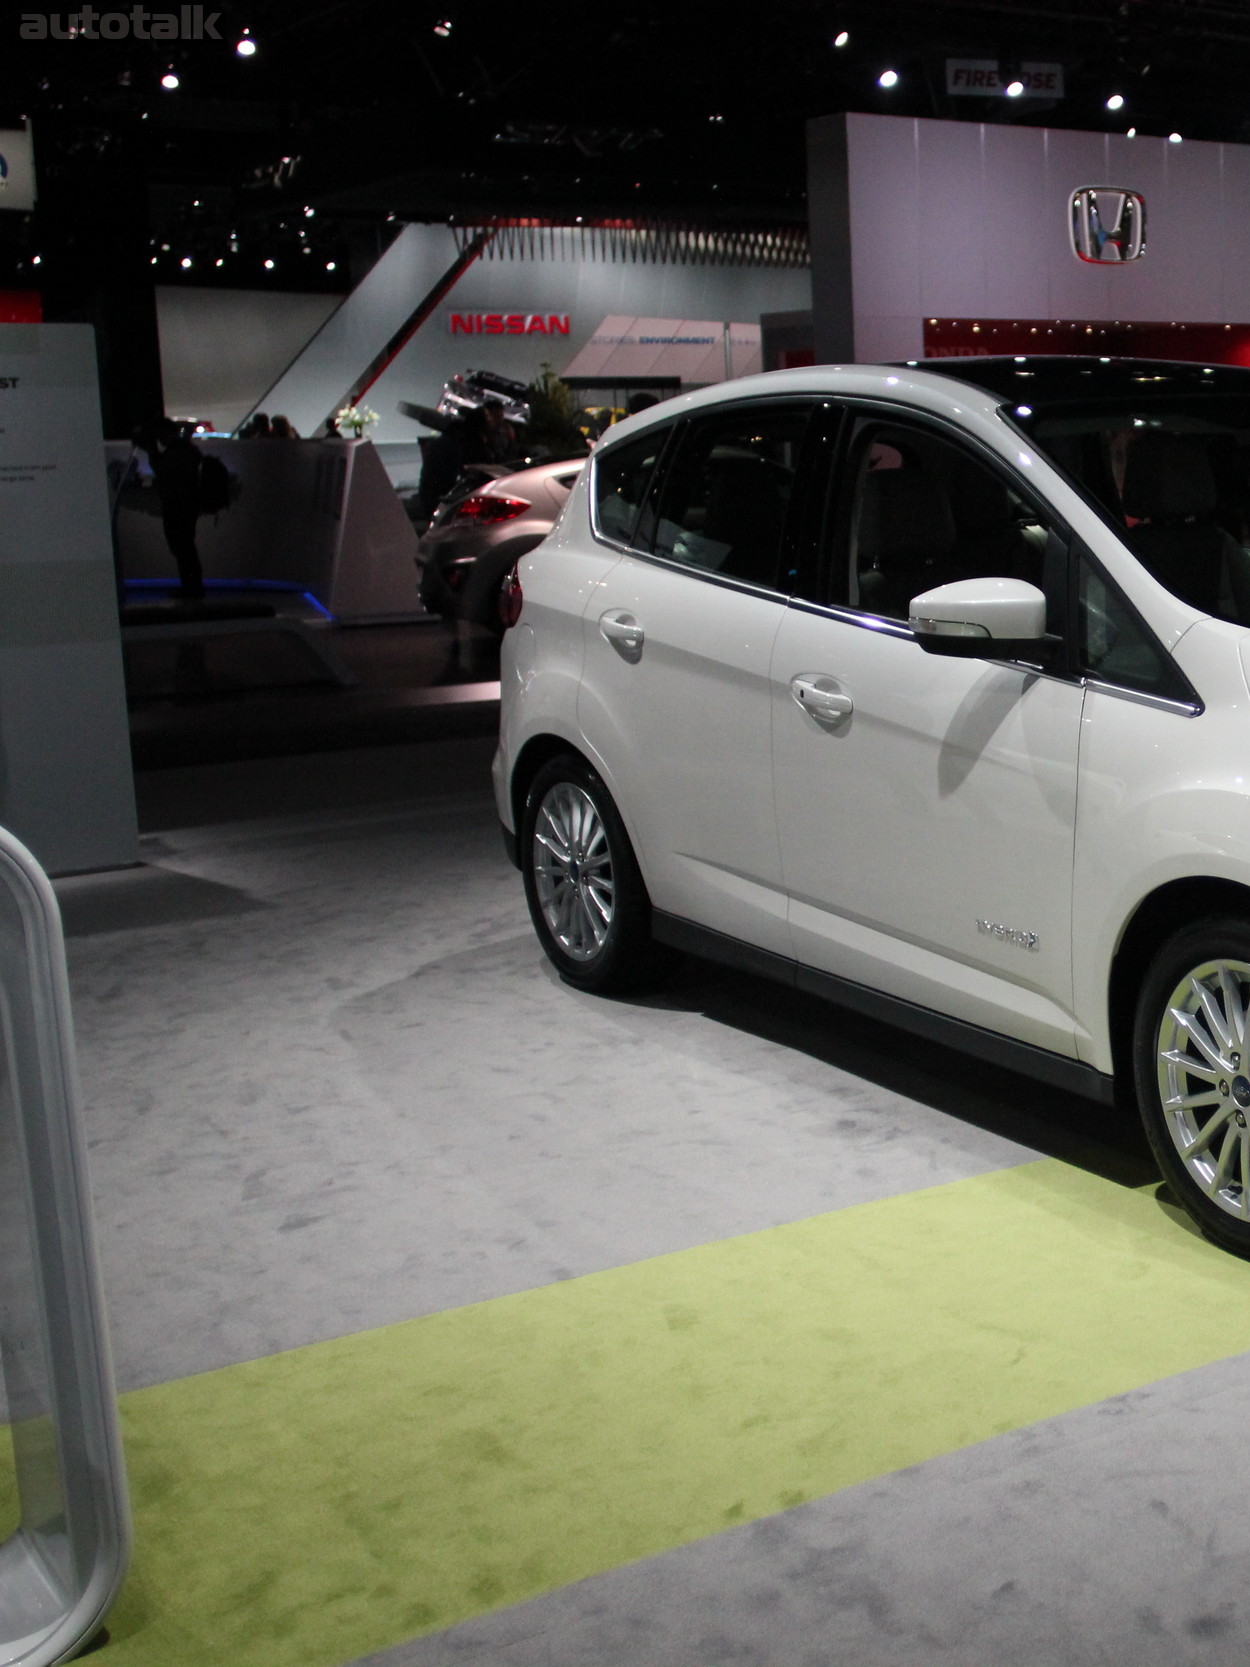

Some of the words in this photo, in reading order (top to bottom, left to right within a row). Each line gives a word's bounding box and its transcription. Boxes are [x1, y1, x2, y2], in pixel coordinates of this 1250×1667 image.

[953, 68, 999, 88] FIRE
[1021, 72, 1057, 90] OSE
[450, 313, 571, 335] NISSAN
